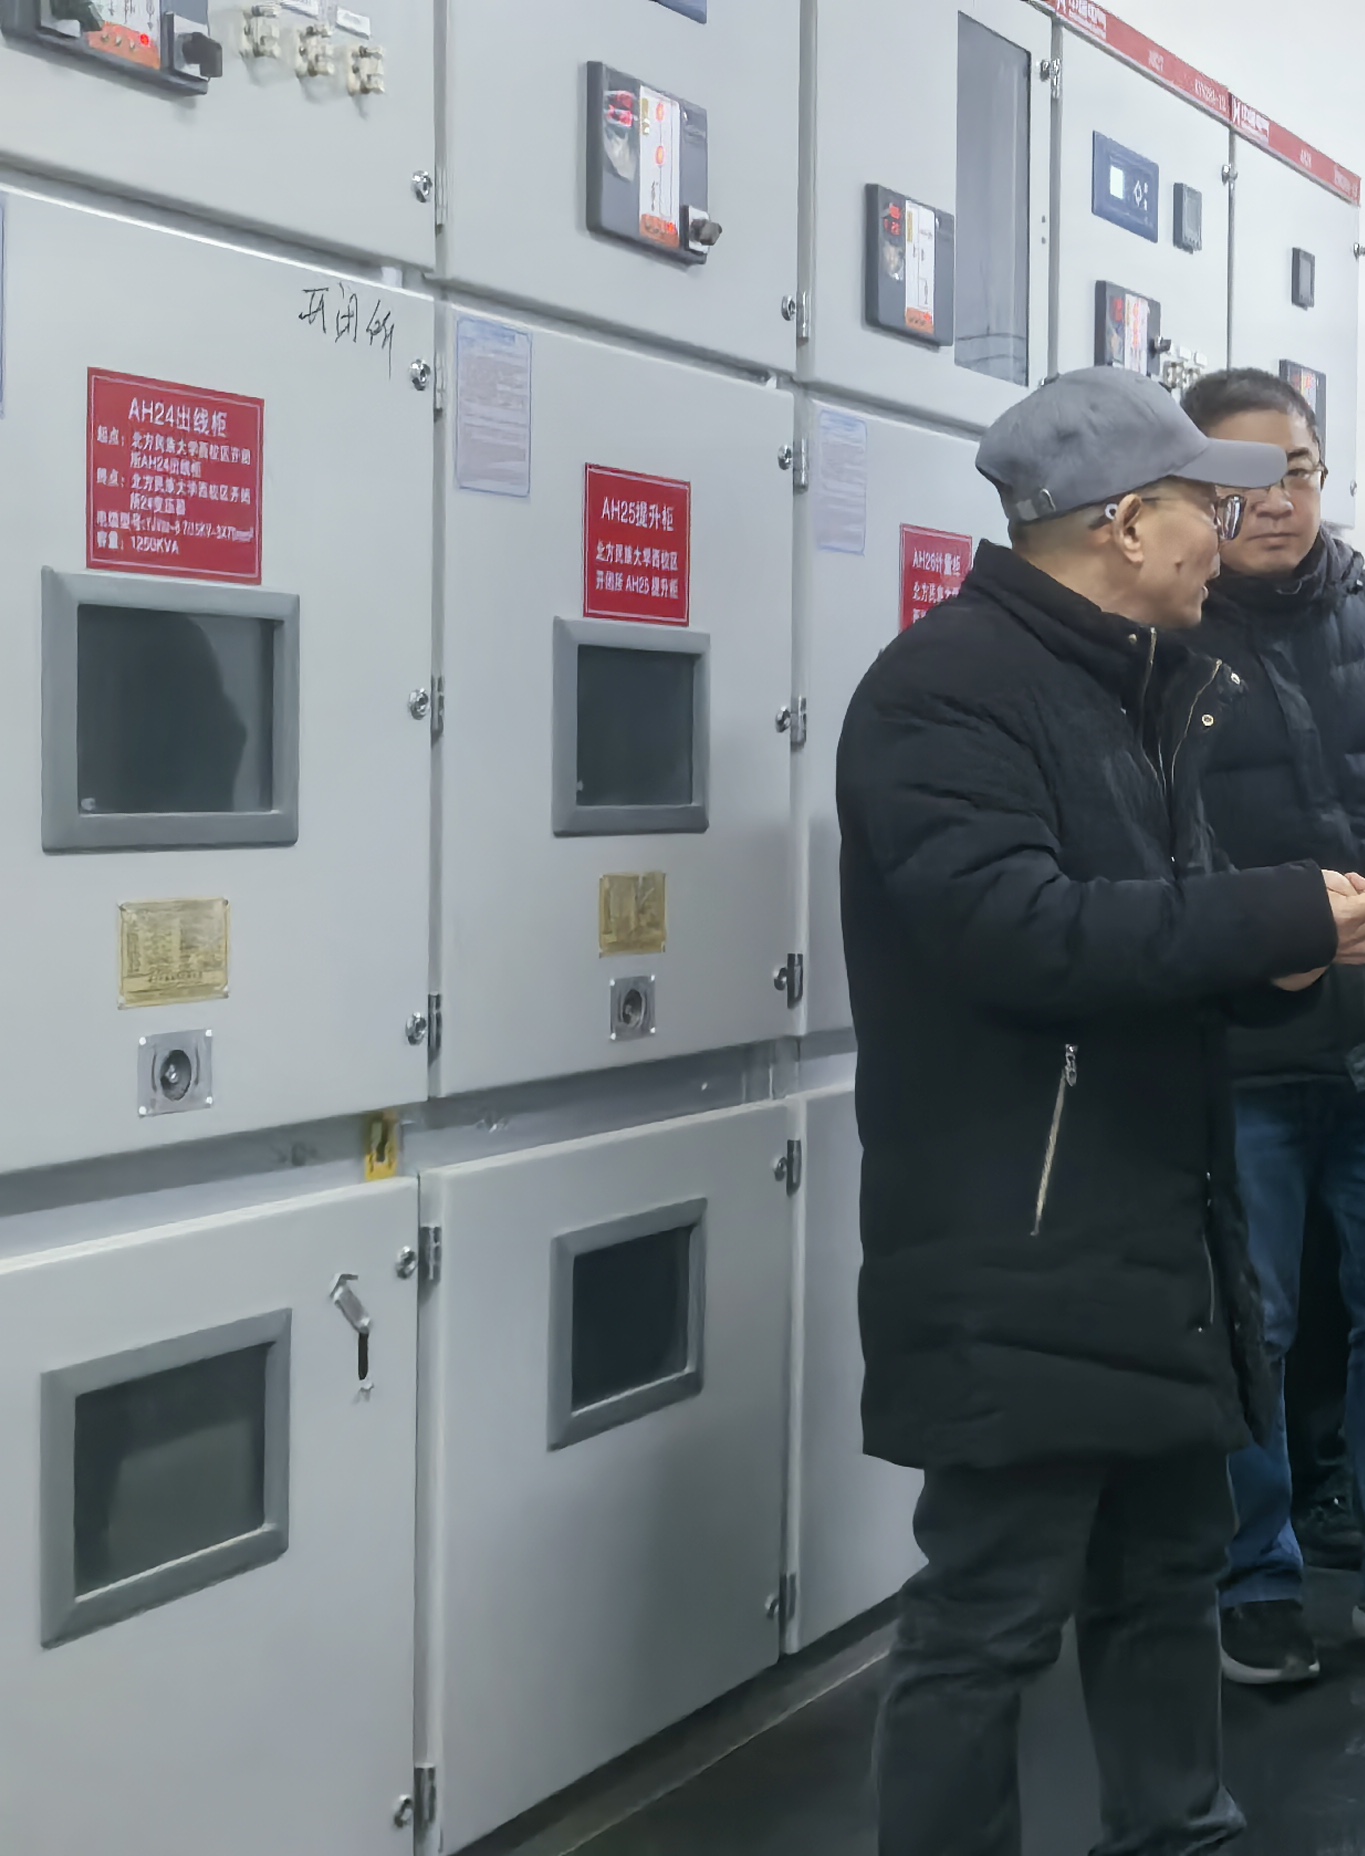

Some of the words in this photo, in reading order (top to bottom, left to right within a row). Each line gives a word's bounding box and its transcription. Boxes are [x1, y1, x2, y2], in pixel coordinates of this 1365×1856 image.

[128, 397, 228, 438] AH24出线柜
[601, 497, 675, 532] AH25提升柜
